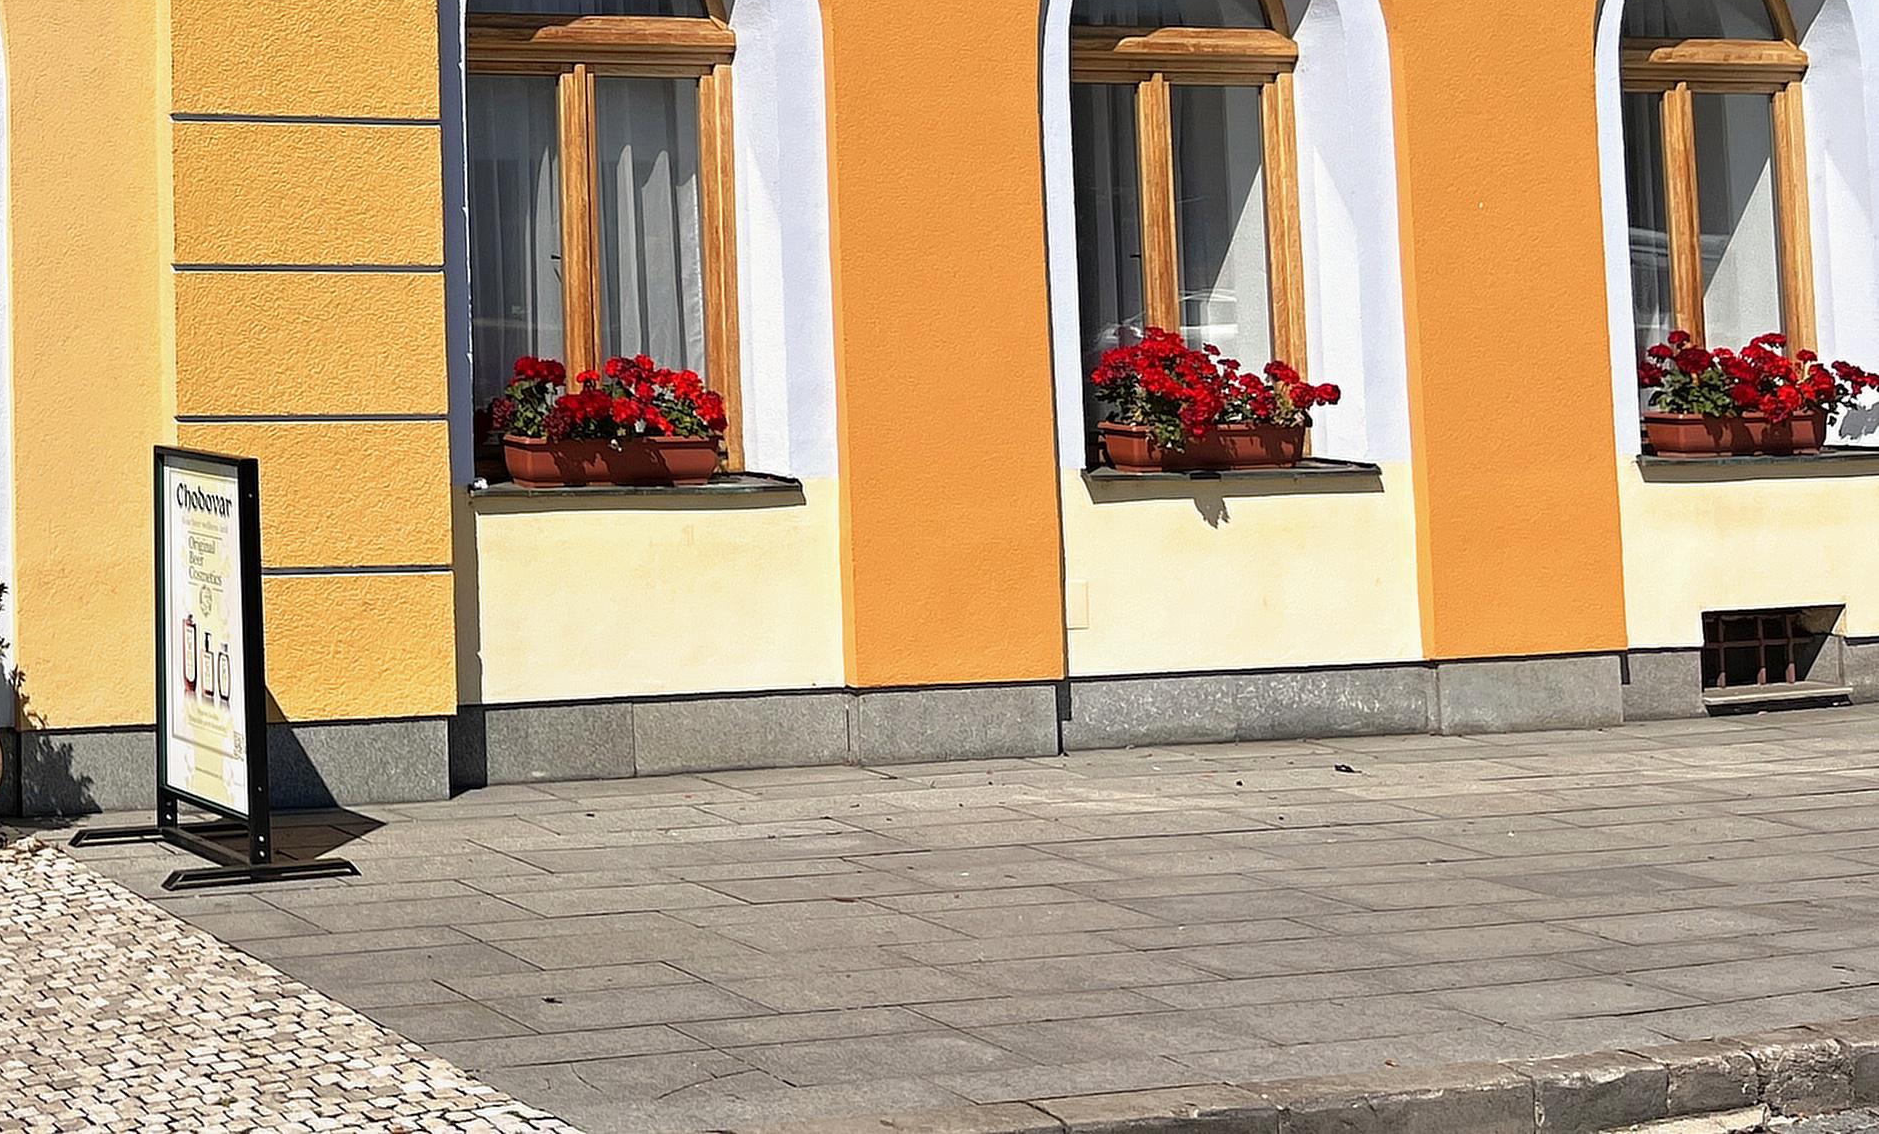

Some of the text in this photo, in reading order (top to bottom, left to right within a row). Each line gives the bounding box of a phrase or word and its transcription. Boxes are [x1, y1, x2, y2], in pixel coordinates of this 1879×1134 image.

[176, 482, 232, 518] Chodovar
[188, 535, 216, 555] Original
[189, 551, 204, 566] Beer
[188, 566, 223, 586] Cosmetics
